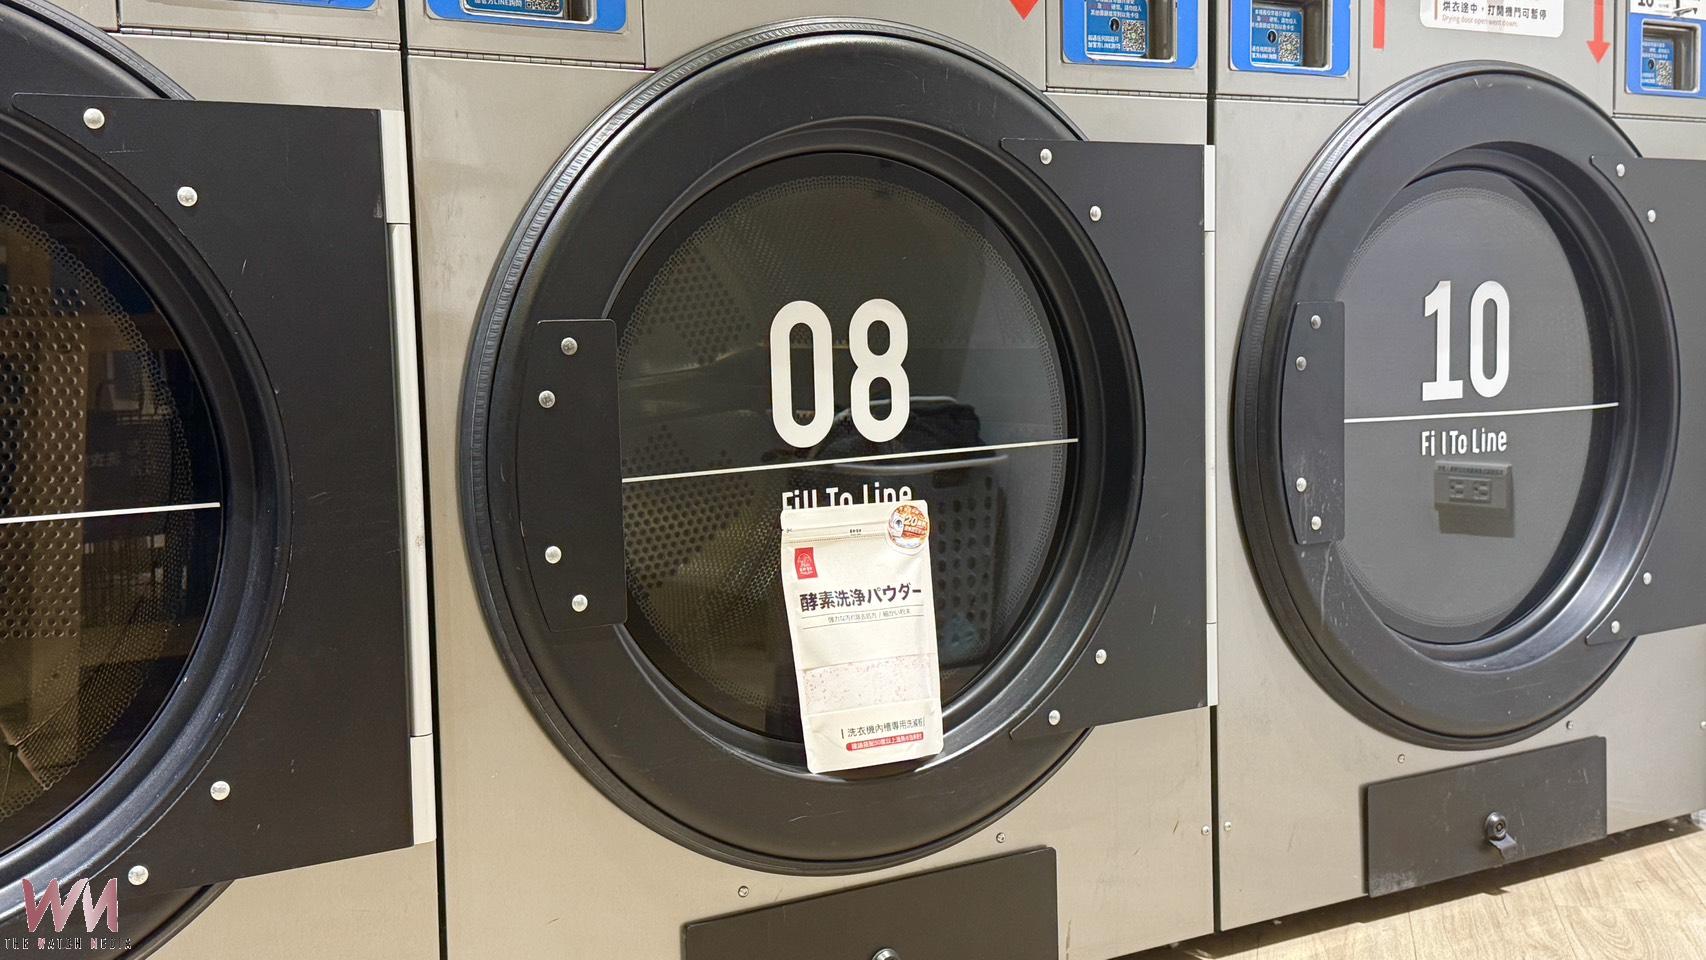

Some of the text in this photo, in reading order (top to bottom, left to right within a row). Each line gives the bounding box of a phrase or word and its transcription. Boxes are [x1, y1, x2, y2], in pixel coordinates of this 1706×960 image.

[769, 298, 910, 448] 08
[1422, 280, 1510, 402] 10
[1449, 430, 1468, 455] To
[1472, 427, 1508, 454] Line
[799, 582, 922, 612] 酵素洗浄パウダー
